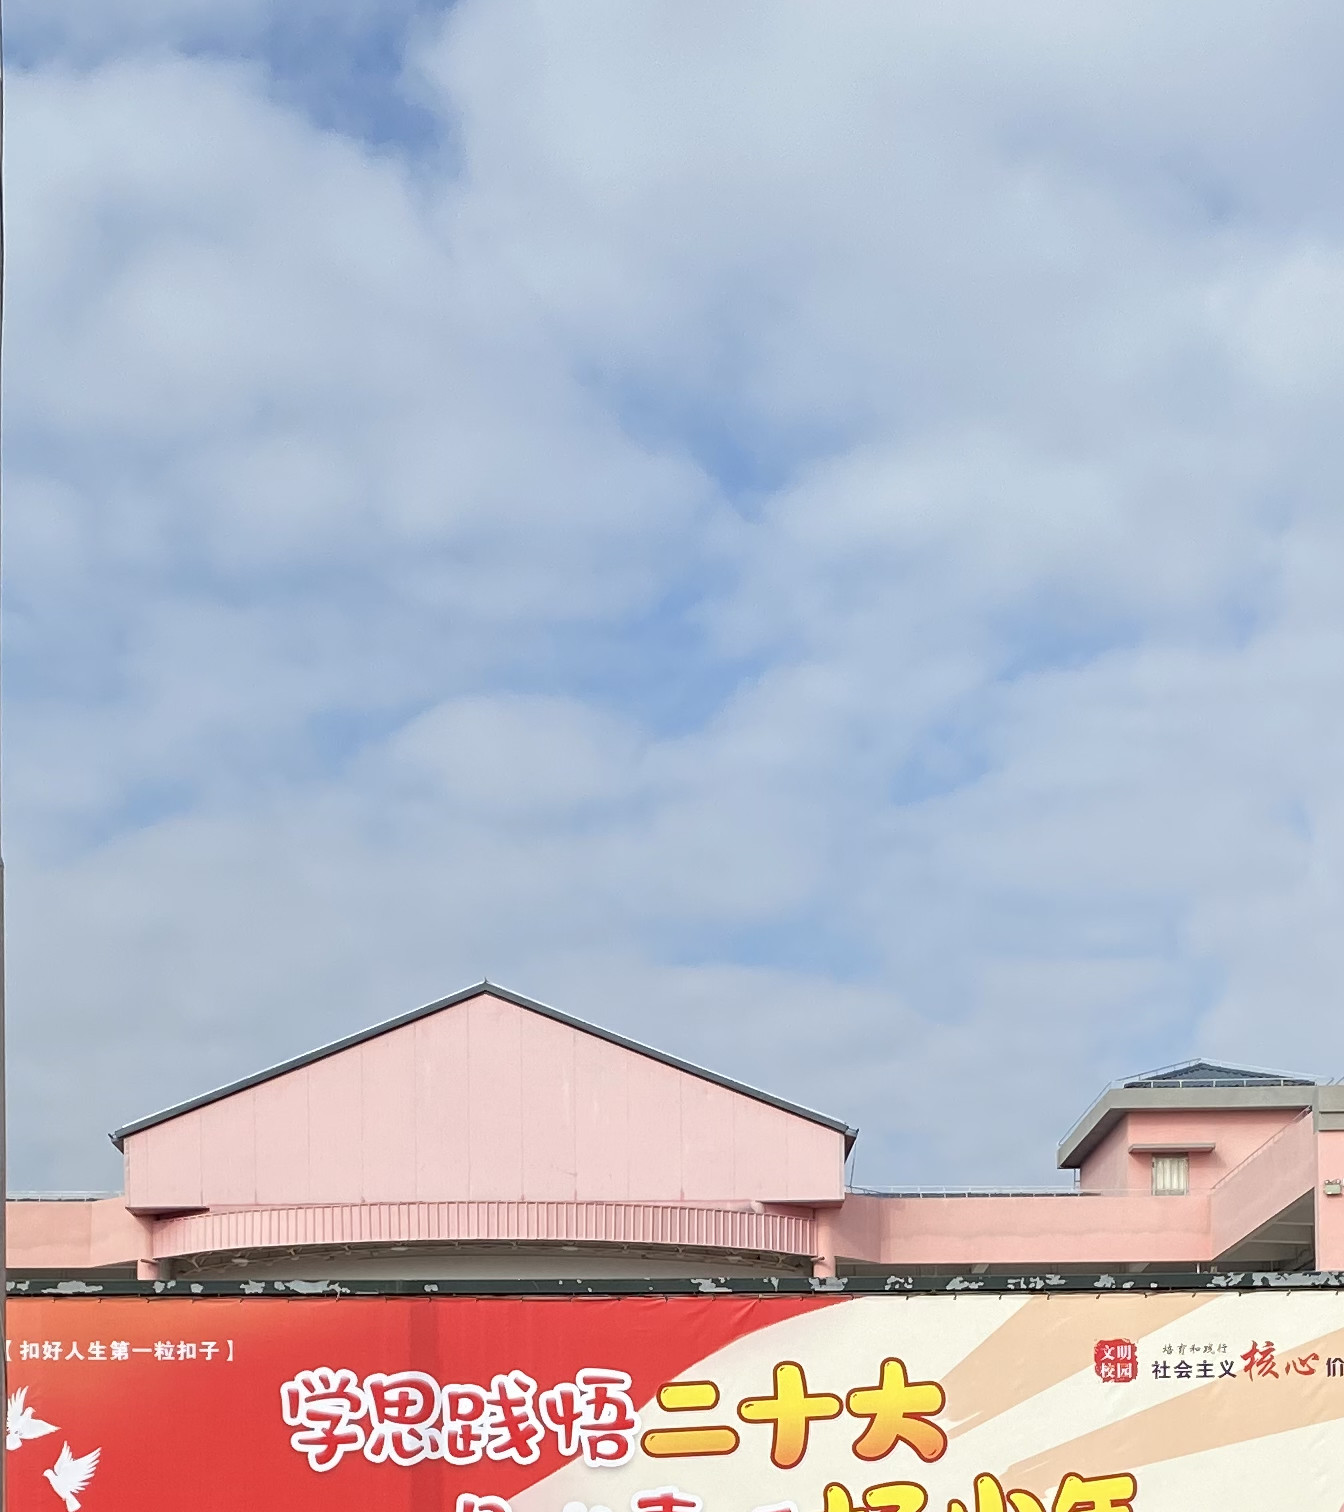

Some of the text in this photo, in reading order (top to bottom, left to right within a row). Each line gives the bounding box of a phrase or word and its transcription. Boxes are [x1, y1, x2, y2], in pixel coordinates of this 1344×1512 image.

[1100, 1344, 1132, 1360] 文明
[1162, 1343, 1228, 1355] 培育和践行
[1099, 1361, 1134, 1379] 校园
[280, 1356, 949, 1472] 学思践悟二十大
